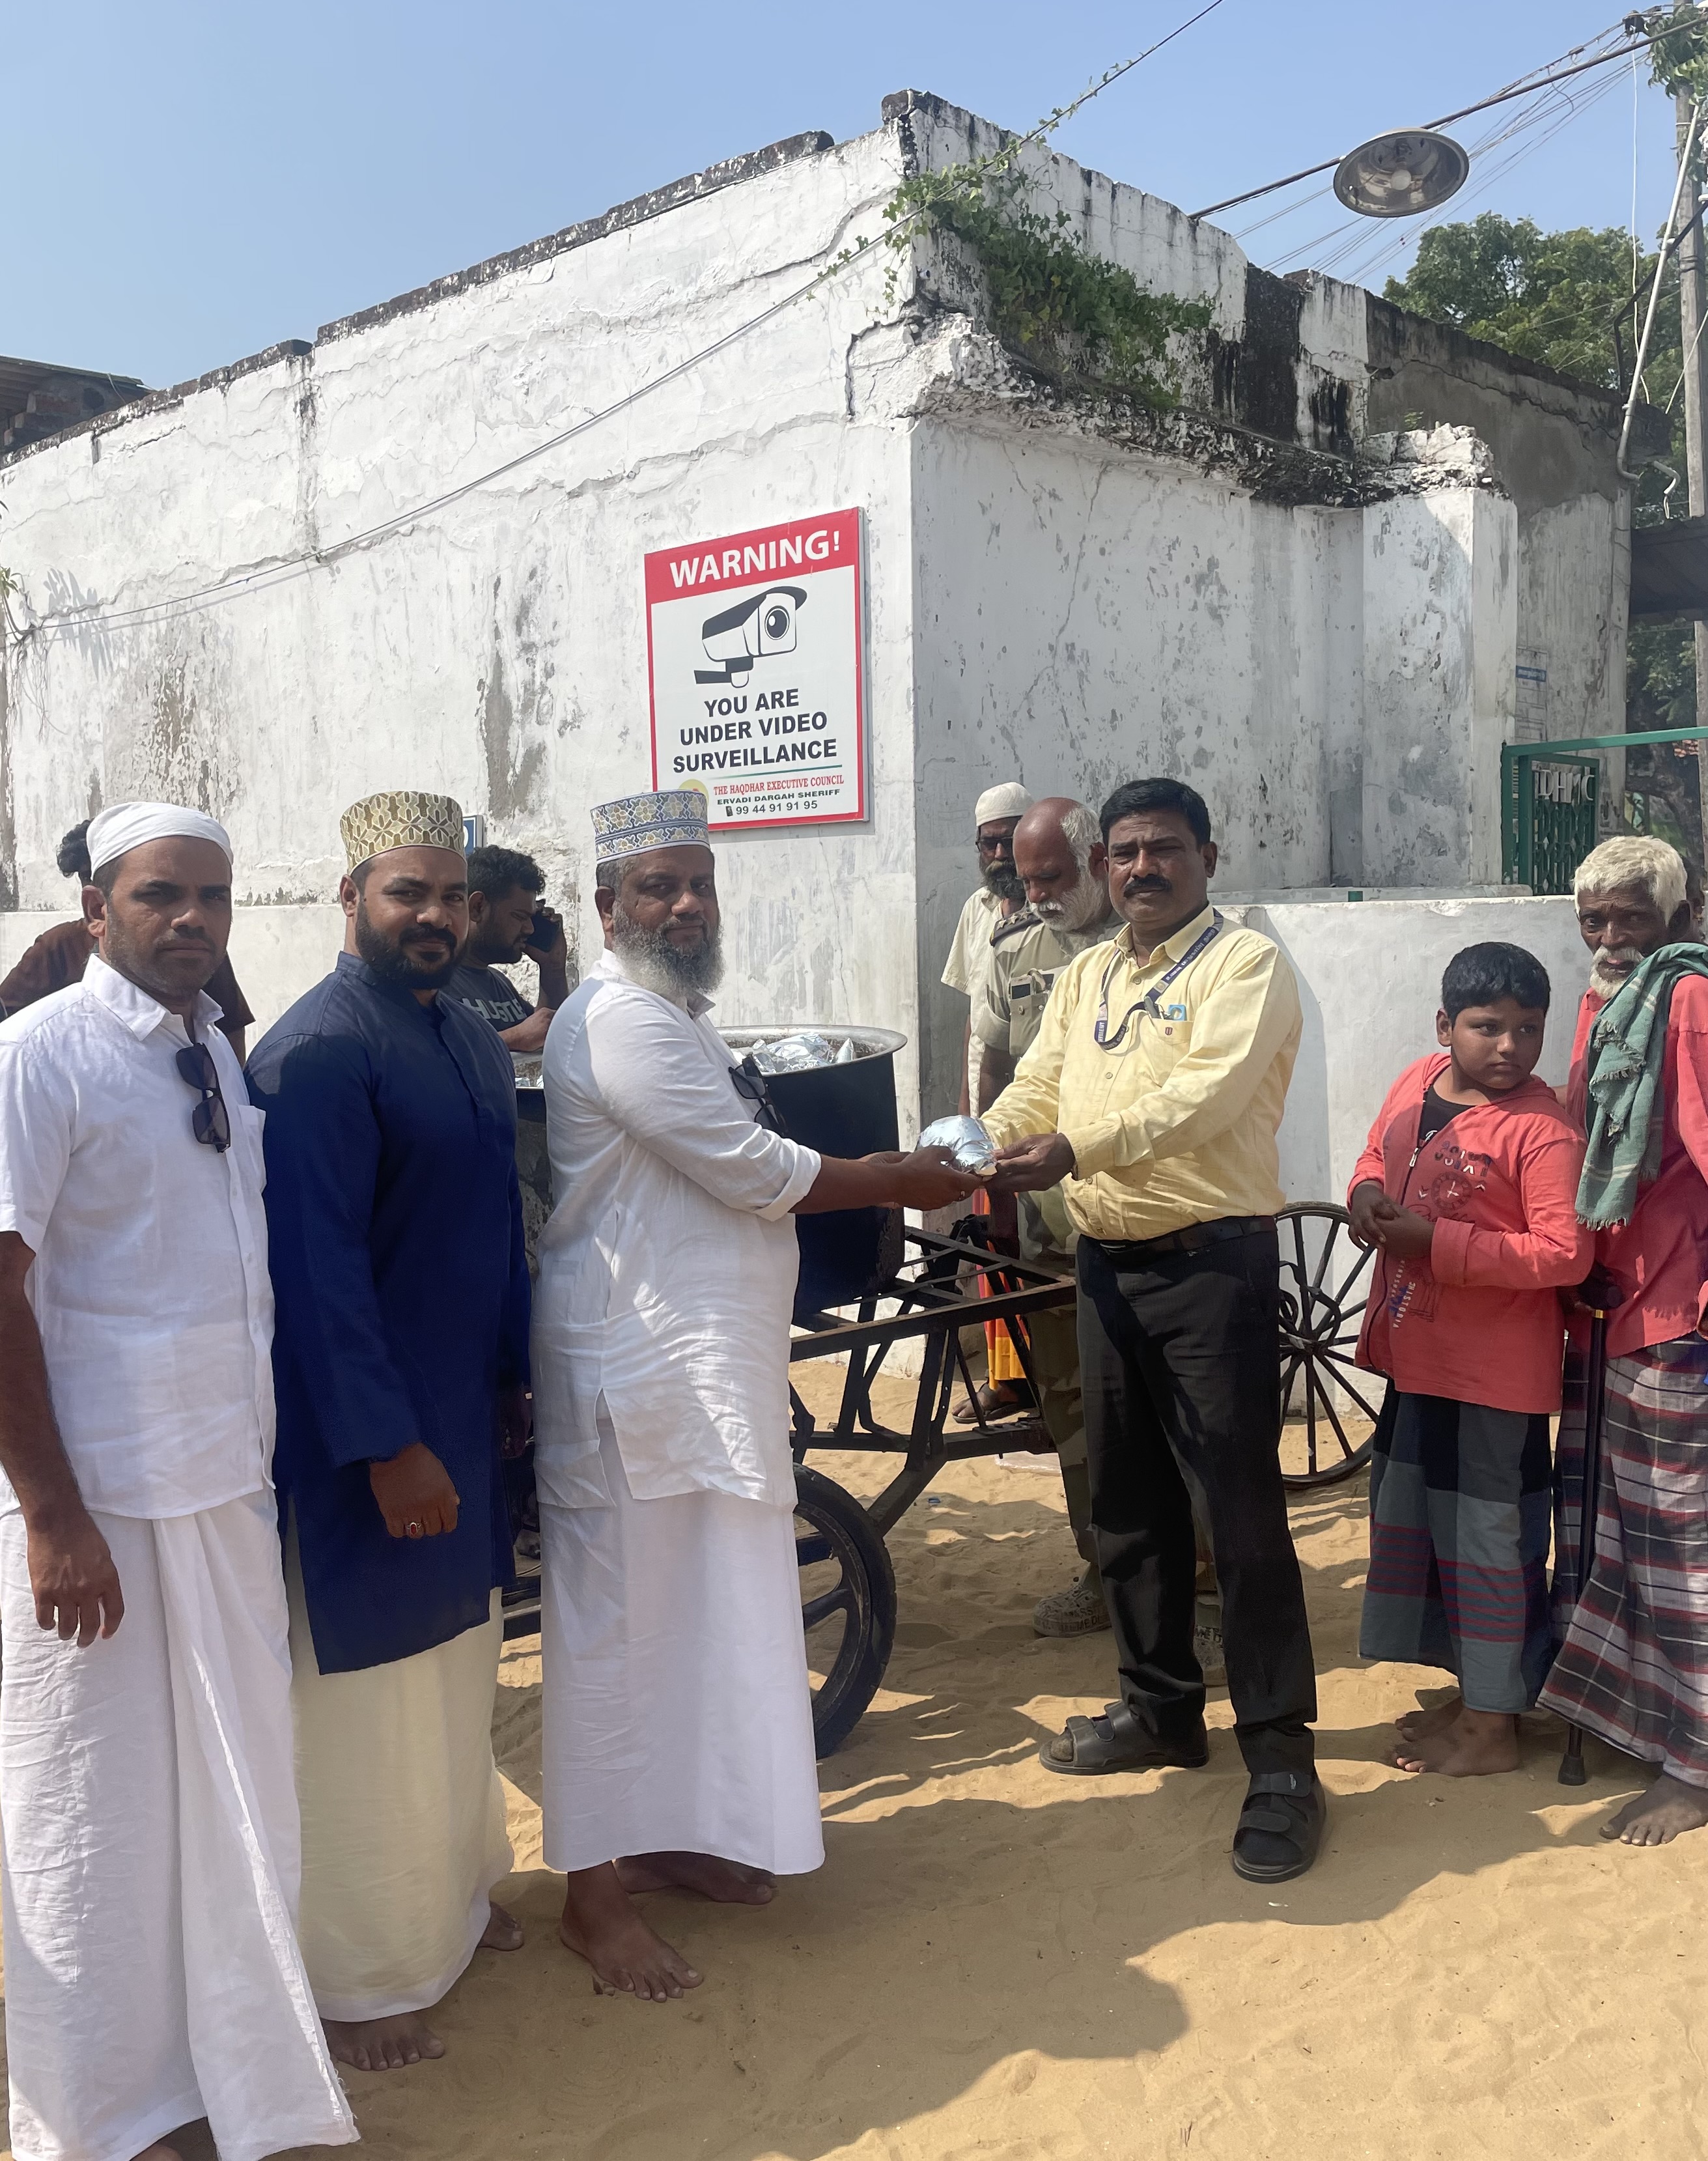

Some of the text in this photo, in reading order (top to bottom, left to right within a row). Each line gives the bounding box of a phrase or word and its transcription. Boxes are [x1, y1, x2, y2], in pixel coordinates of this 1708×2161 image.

[669, 530, 839, 588] WARNING!
[704, 688, 799, 717] YOU ARE
[680, 711, 827, 746] UNDER VIDEO
[673, 739, 837, 773] SURVEILLANCE
[714, 774, 845, 795] THE HAQDHAR EXECUTIVE COUNCIL
[718, 789, 840, 805] ERVADI DARGAH SHERIFF
[736, 800, 818, 815] 99 44 91 91 95
[462, 998, 527, 1023] HUSTLE
